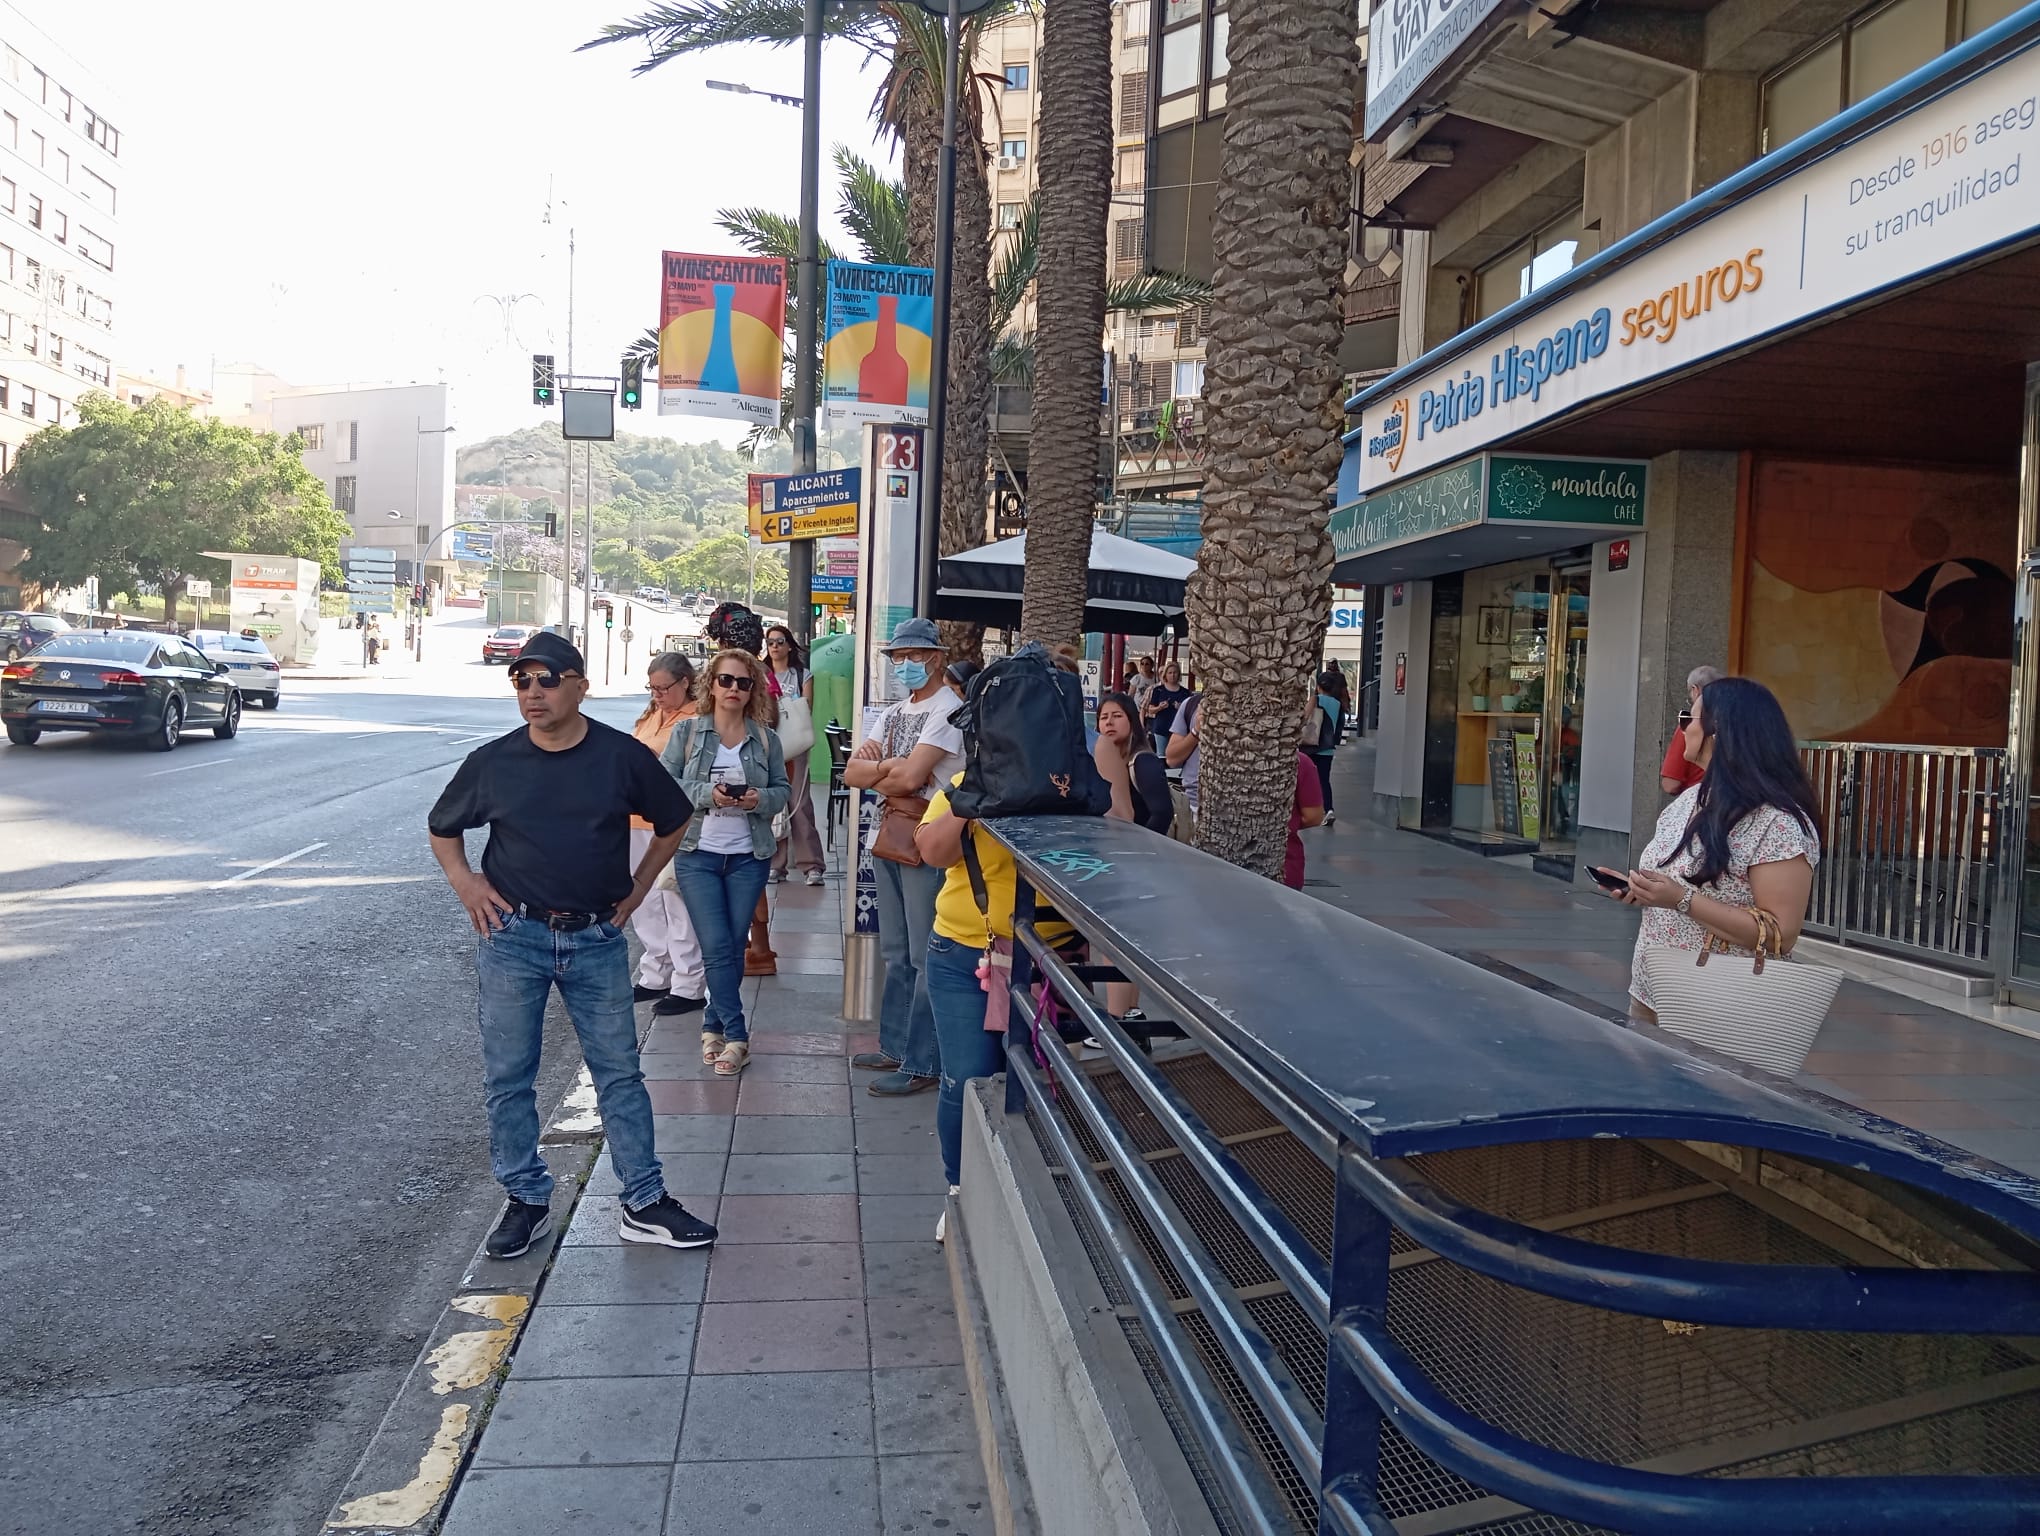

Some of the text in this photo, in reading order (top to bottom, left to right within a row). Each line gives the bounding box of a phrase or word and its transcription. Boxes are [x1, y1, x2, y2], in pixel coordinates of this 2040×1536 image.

[1850, 97, 2036, 206] Desde 1916 aseg
[1846, 153, 2021, 256] su tranquilidad
[669, 258, 782, 286] WINECANTING
[834, 266, 934, 297] WINECANTIN
[668, 282, 677, 290] 29
[678, 282, 696, 292] MAYO
[834, 292, 842, 302] 29
[842, 294, 862, 304] MAYO
[1418, 248, 1764, 440] Patria Hispana seguros
[737, 401, 773, 415] Alicante
[900, 412, 928, 424] Alican
[1384, 414, 1402, 433] Patria
[881, 434, 916, 470] 23
[1369, 430, 1402, 458] Hispana
[788, 474, 843, 492] ALICANTE
[1552, 470, 1638, 500] mandala
[782, 490, 850, 508] Aparcamientos
[1614, 504, 1636, 520] CAFÉ
[780, 518, 790, 535] P
[803, 518, 827, 528] Vicente
[829, 516, 855, 526] Inglada
[262, 567, 287, 576] TRAM
[44, 702, 87, 712] 3226 KLX
